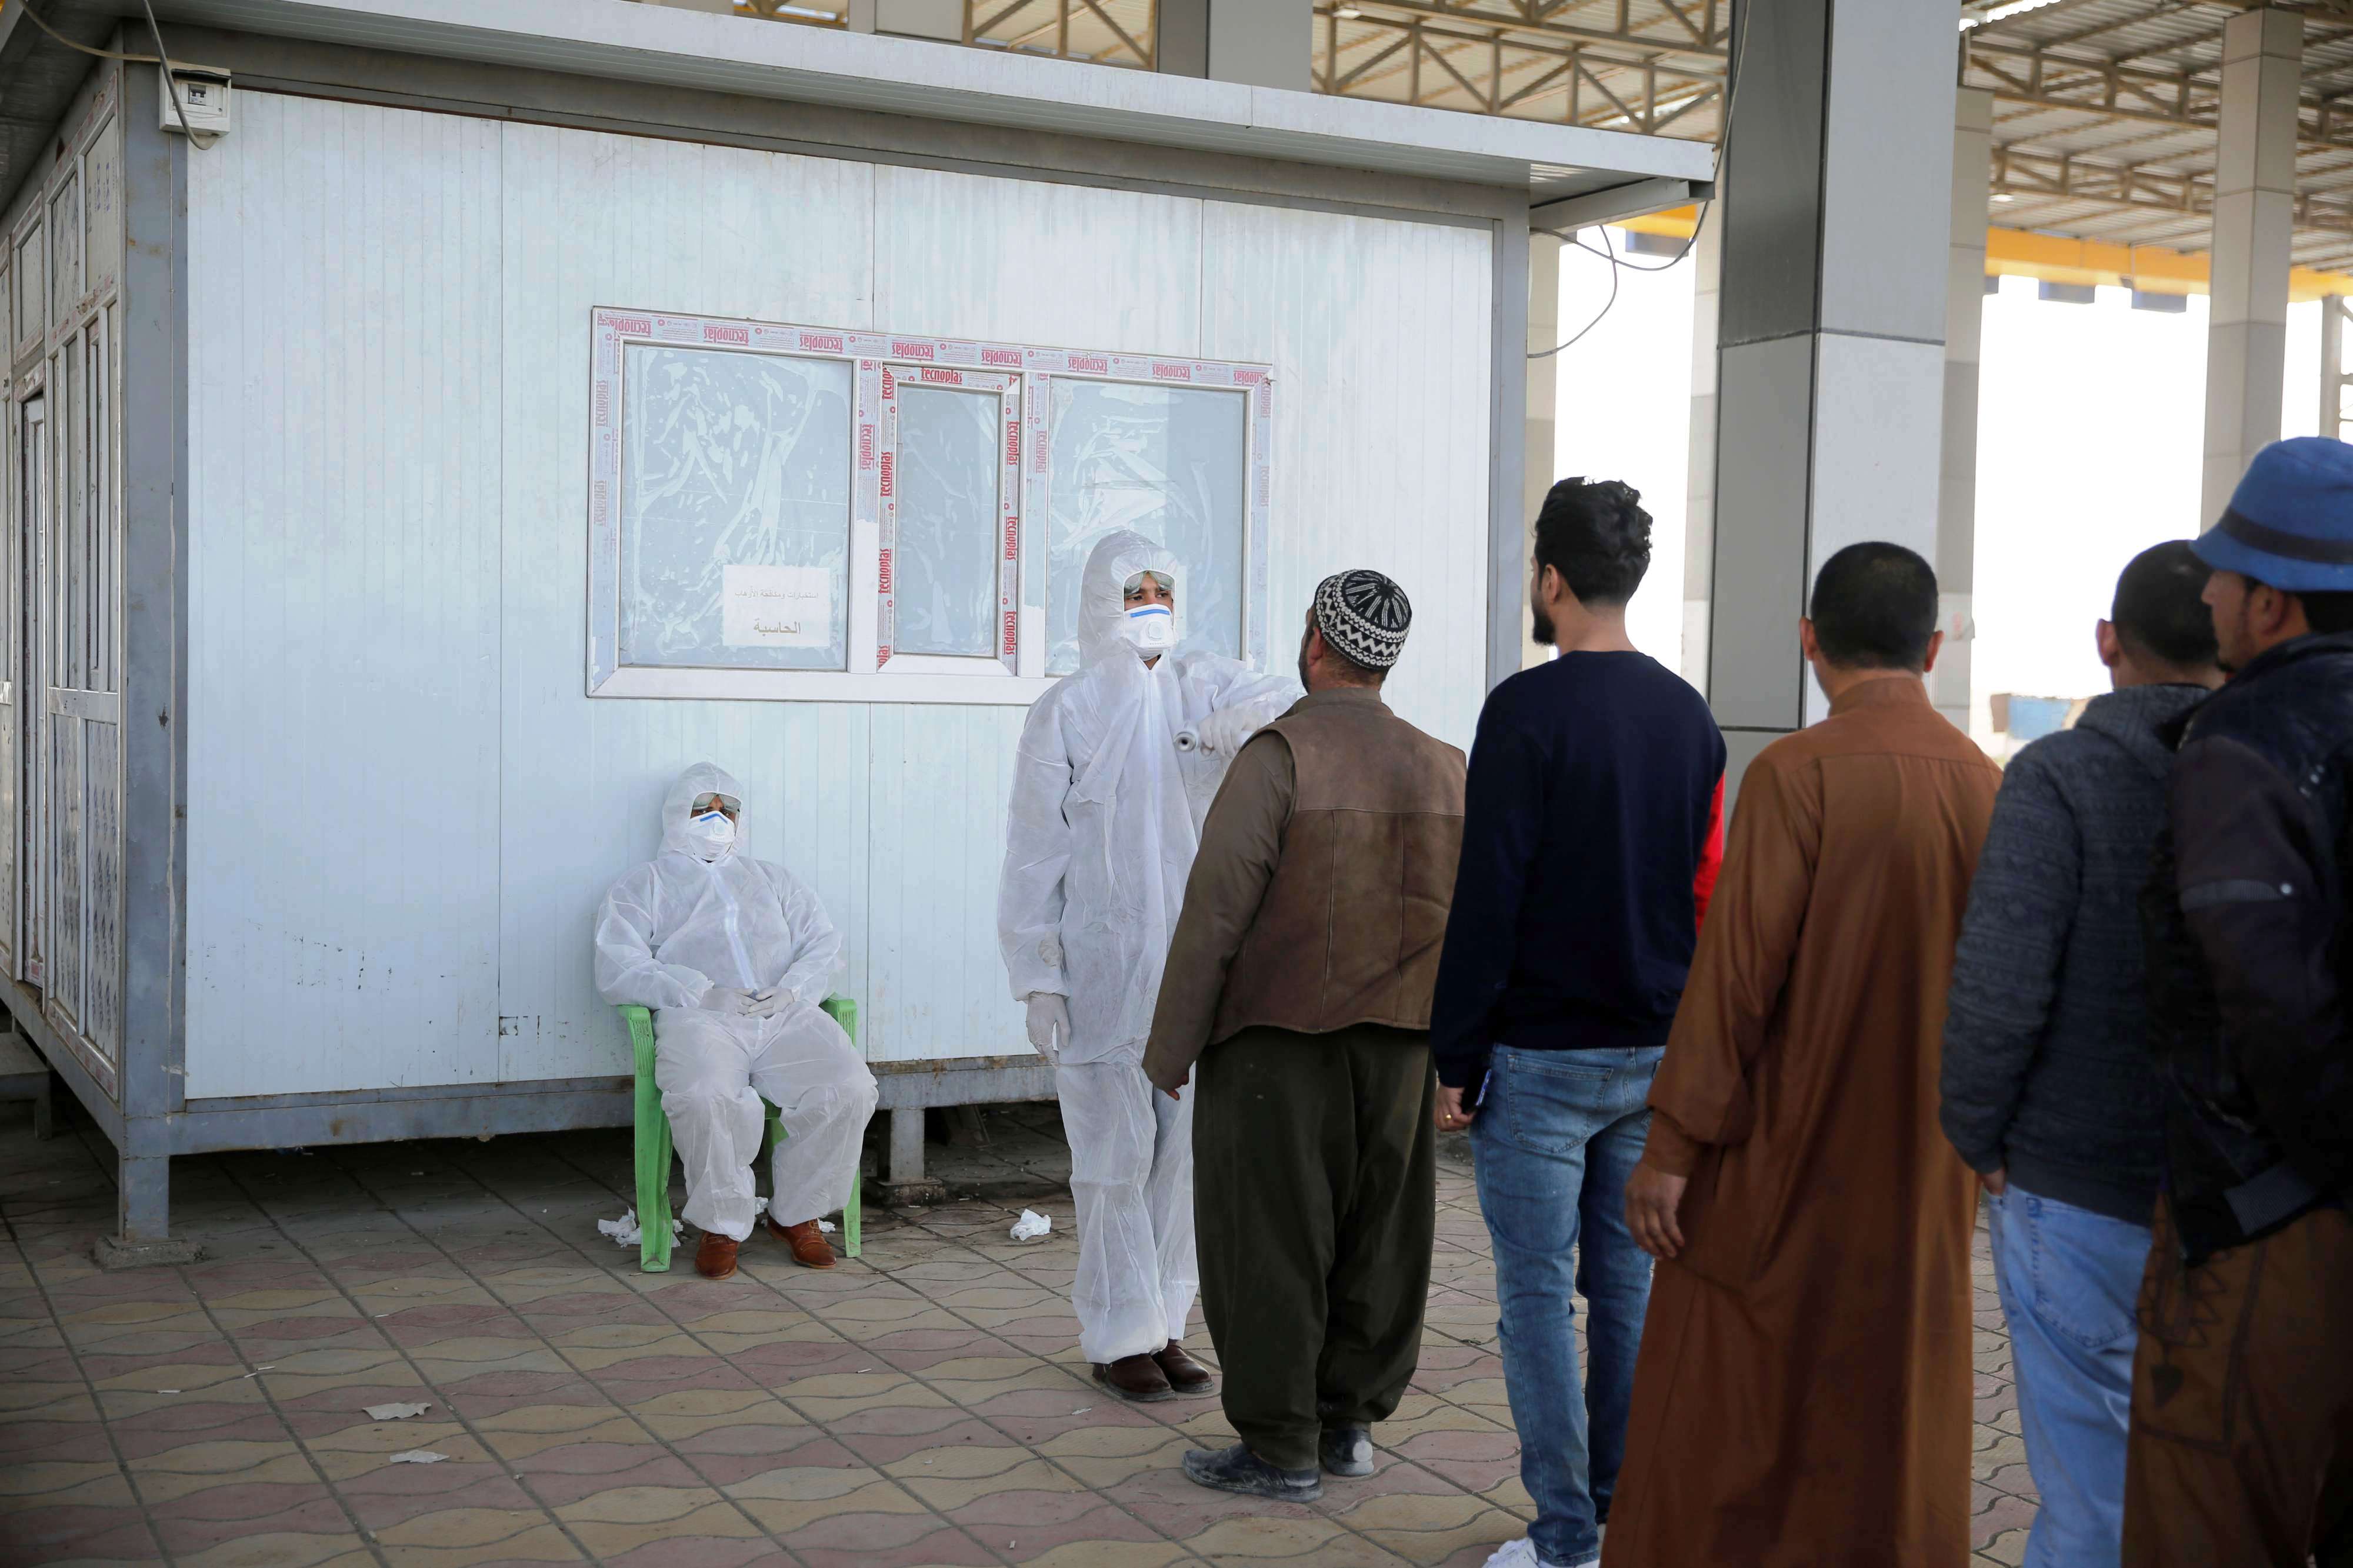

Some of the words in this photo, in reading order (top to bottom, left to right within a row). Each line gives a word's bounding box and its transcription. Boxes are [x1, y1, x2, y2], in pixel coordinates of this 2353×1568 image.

[704, 326, 749, 345] tecnoplas
[799, 333, 844, 352] tecnoplas
[892, 343, 934, 360] tecnoplas
[981, 349, 1022, 366] tecnoplas
[1068, 357, 1108, 373] tecnoplas
[921, 368, 962, 384] tecnoplas
[1152, 364, 1191, 381] tecnoplas
[596, 381, 609, 426] tecnoplas
[860, 423, 875, 471] tecnoplas
[1006, 421, 1019, 466] tecnoplas
[1036, 431, 1047, 473] tecnoplas
[880, 452, 893, 497] tecnoplas
[1005, 516, 1017, 561] tecnoplas
[878, 549, 891, 593] tecnoplas
[754, 618, 801, 636] الحاسبة
[1004, 611, 1016, 655] tecnoplas
